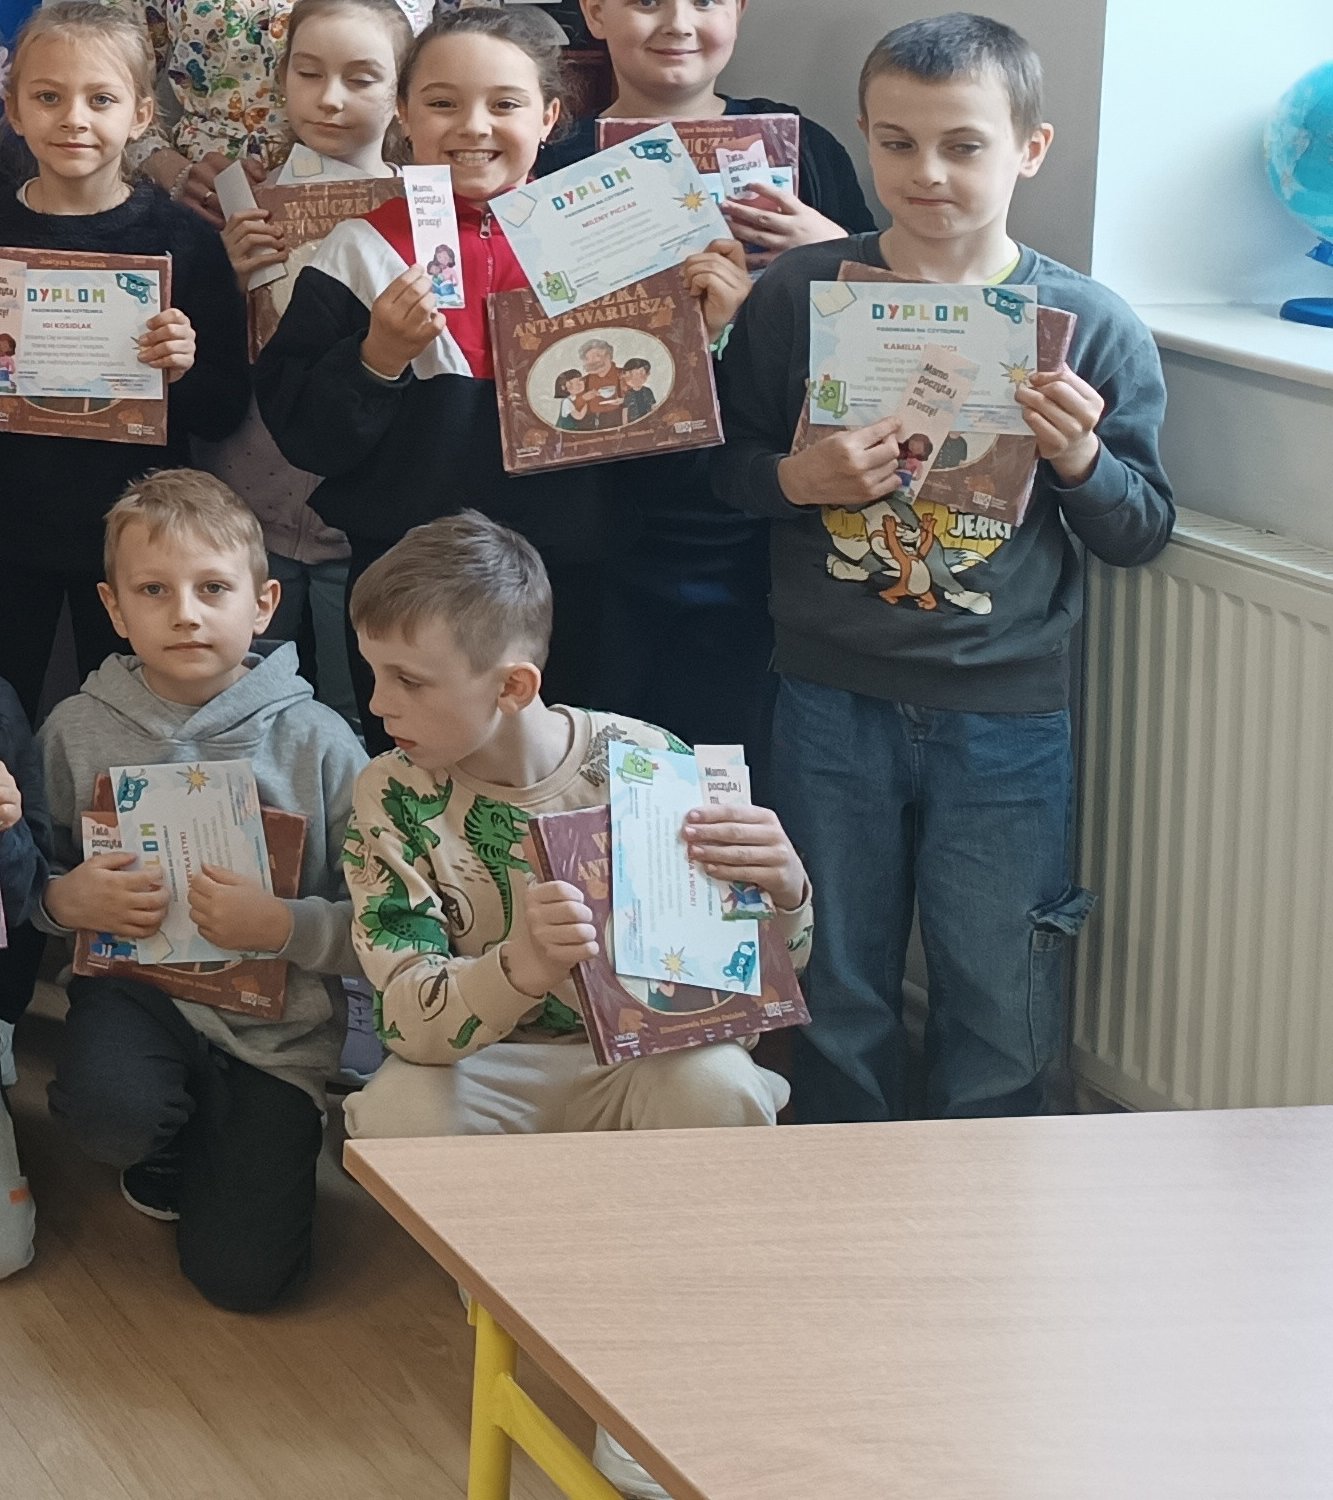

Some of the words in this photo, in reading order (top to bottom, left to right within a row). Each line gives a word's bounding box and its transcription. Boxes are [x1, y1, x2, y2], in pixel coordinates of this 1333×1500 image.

[551, 167, 632, 211] DYPLOM
[26, 288, 106, 303] DYPLOM
[512, 296, 676, 338] ANTYKWARIUSZA
[871, 303, 969, 322] DYPLOM
[923, 363, 950, 382] Mamo,
[917, 375, 958, 399] poczytaj
[92, 839, 123, 850] poczyta
